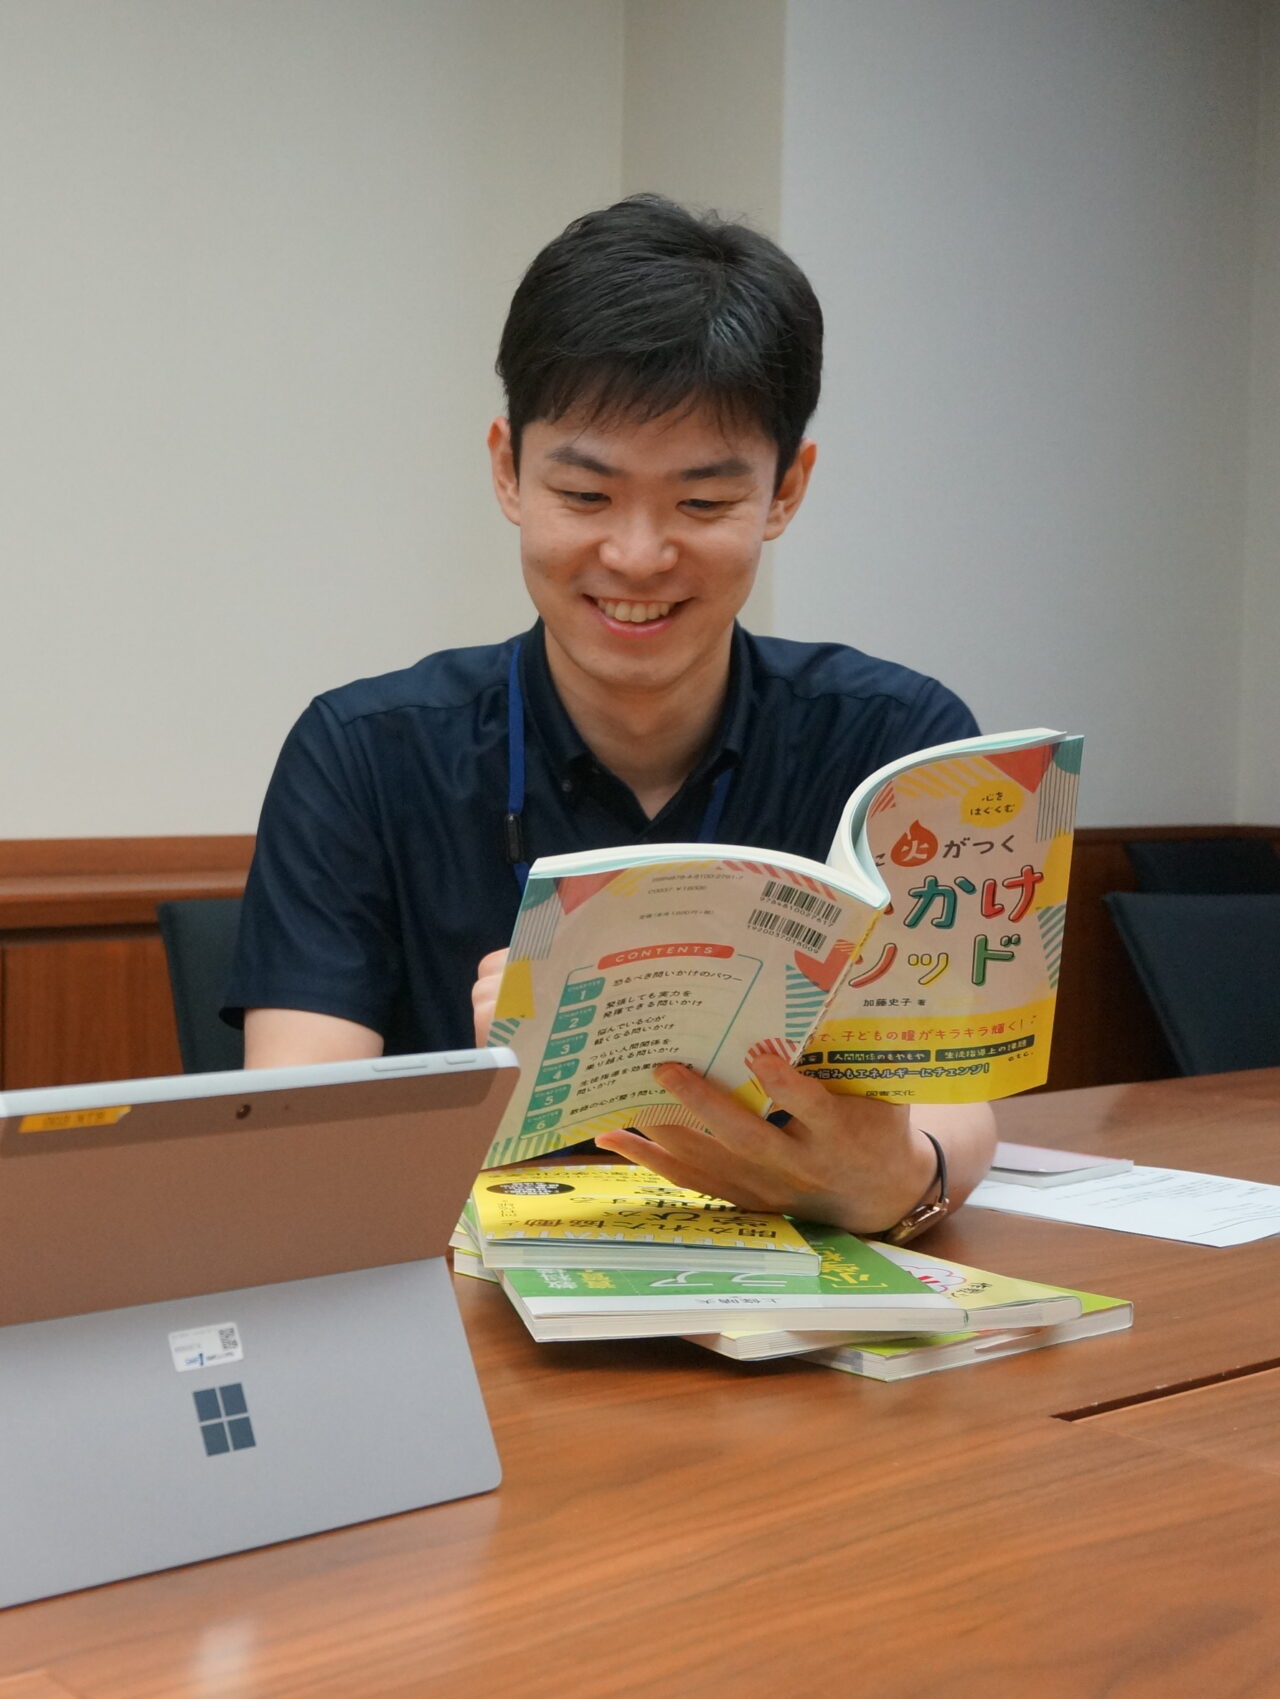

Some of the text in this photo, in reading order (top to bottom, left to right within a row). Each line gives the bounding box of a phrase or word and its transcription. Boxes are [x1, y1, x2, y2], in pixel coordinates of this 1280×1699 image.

[884, 864, 1043, 930] かけ
[615, 946, 714, 963] CONTENTS
[864, 998, 912, 1008] 加藤史子
[568, 1018, 579, 1028] 2
[560, 1044, 570, 1055] 3
[553, 1070, 562, 1080] 4
[544, 1096, 554, 1105] 5
[536, 1121, 546, 1130] 6
[603, 1211, 769, 1229] 学びが
